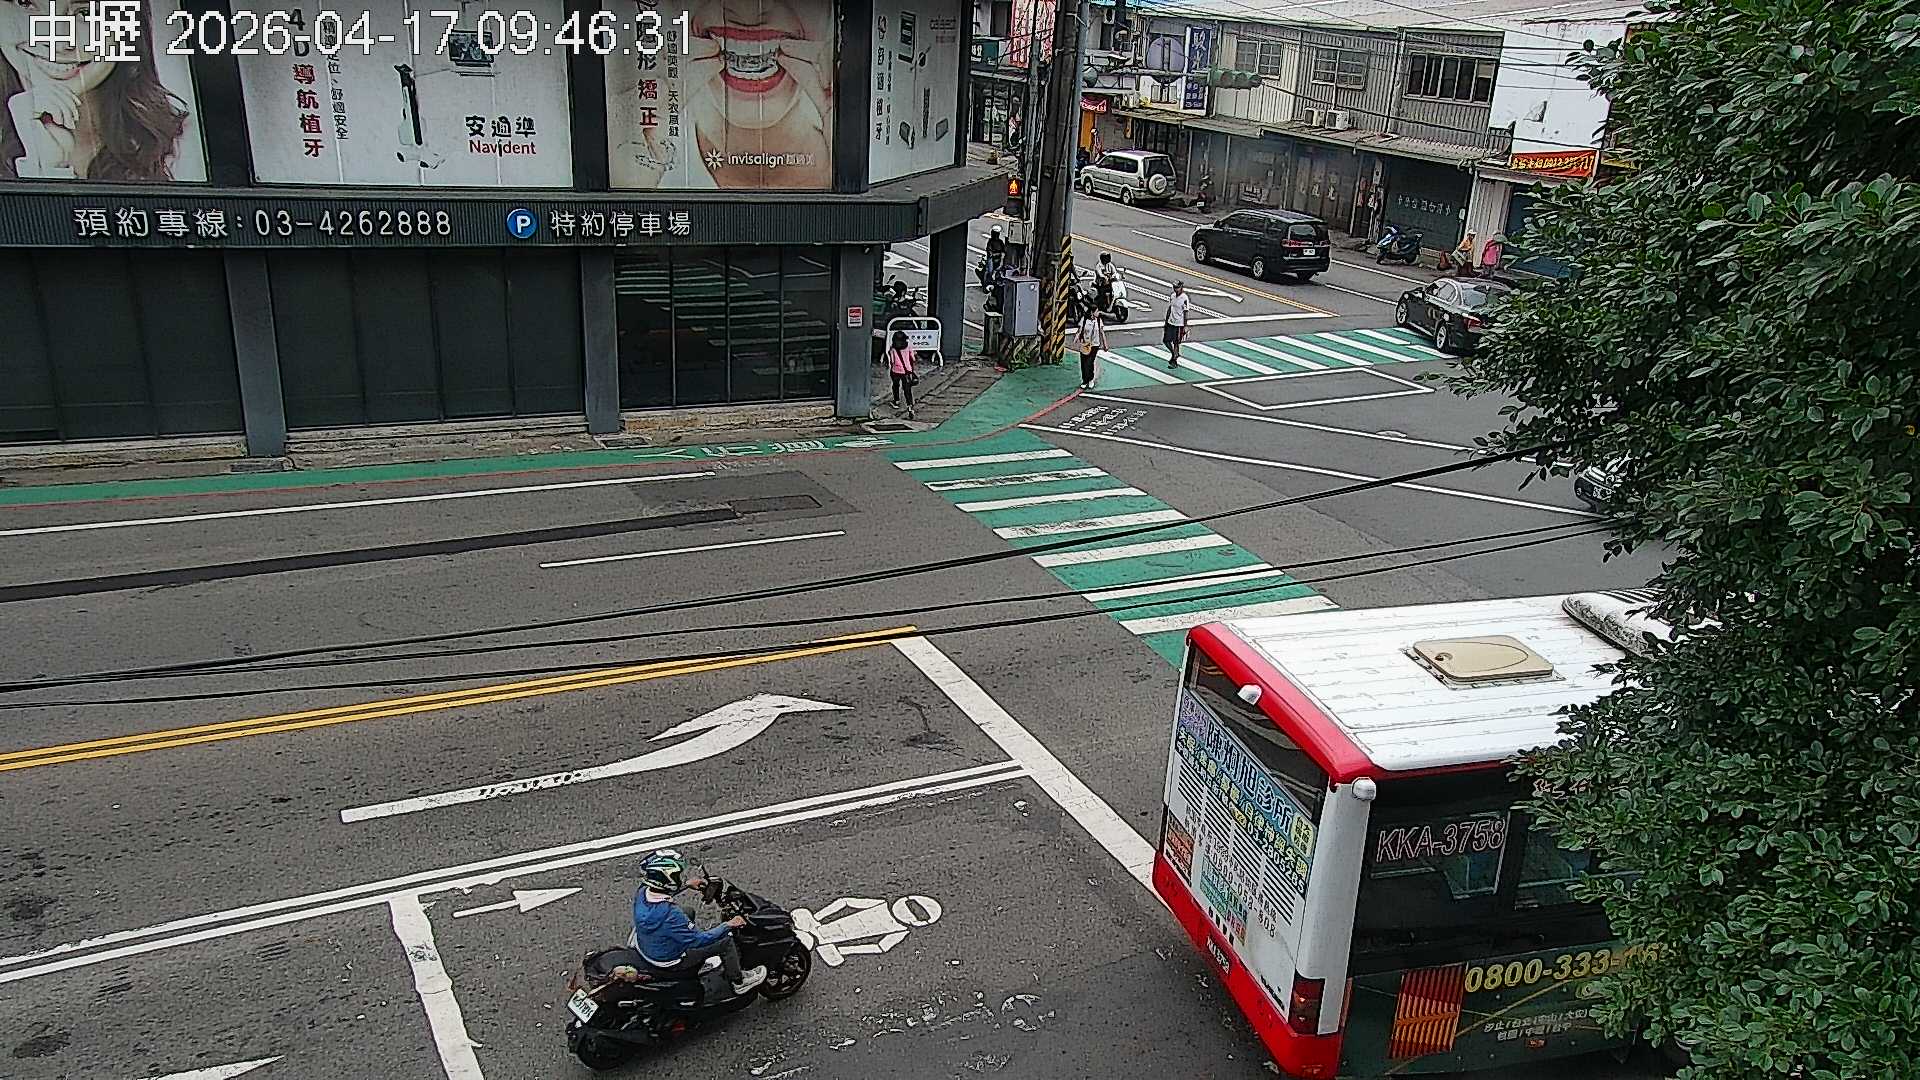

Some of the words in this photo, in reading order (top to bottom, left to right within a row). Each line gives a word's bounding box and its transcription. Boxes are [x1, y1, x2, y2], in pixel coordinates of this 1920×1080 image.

[469, 139, 537, 157] Navident
[727, 151, 784, 169] invisalign
[550, 210, 692, 238] 特約停車場
[1376, 820, 1506, 863] KKA-3758
